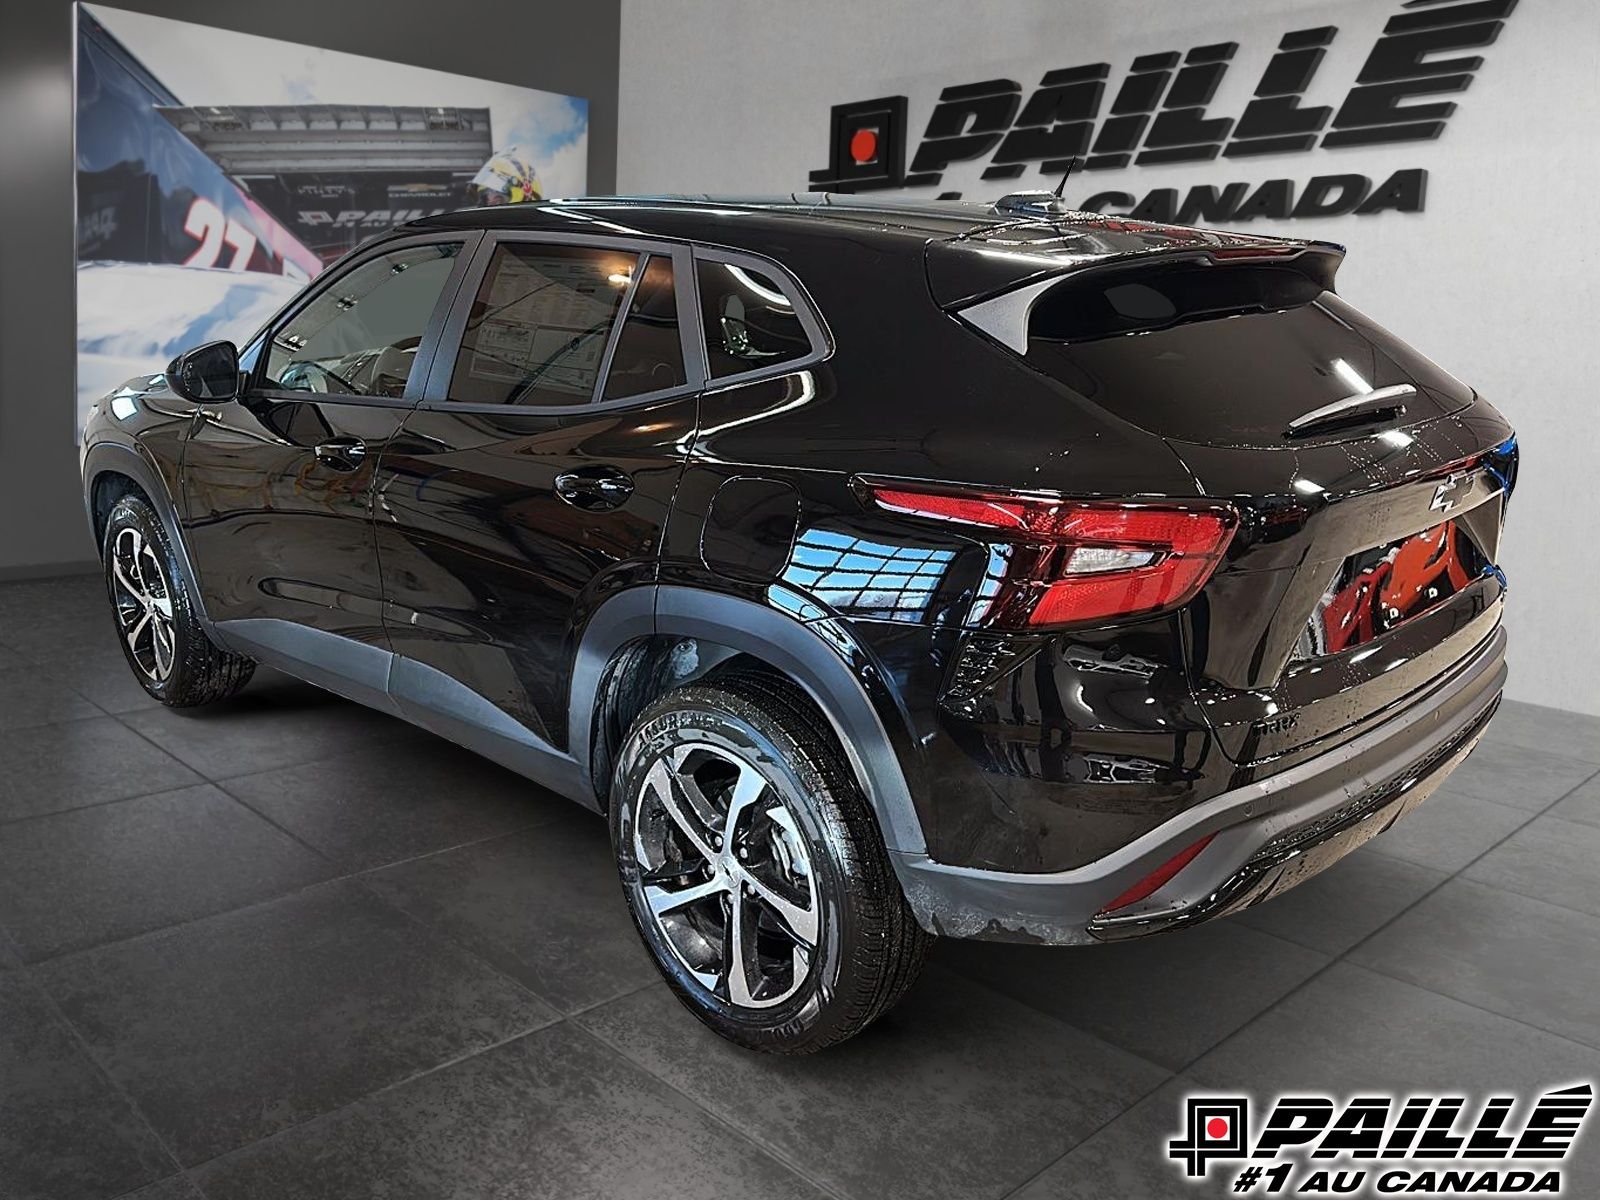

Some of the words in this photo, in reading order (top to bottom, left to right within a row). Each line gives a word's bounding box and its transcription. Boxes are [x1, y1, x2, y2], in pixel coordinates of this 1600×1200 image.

[904, 0, 1519, 186] PAILLÉ
[182, 196, 256, 272] 27
[1078, 168, 1428, 224] CANADA
